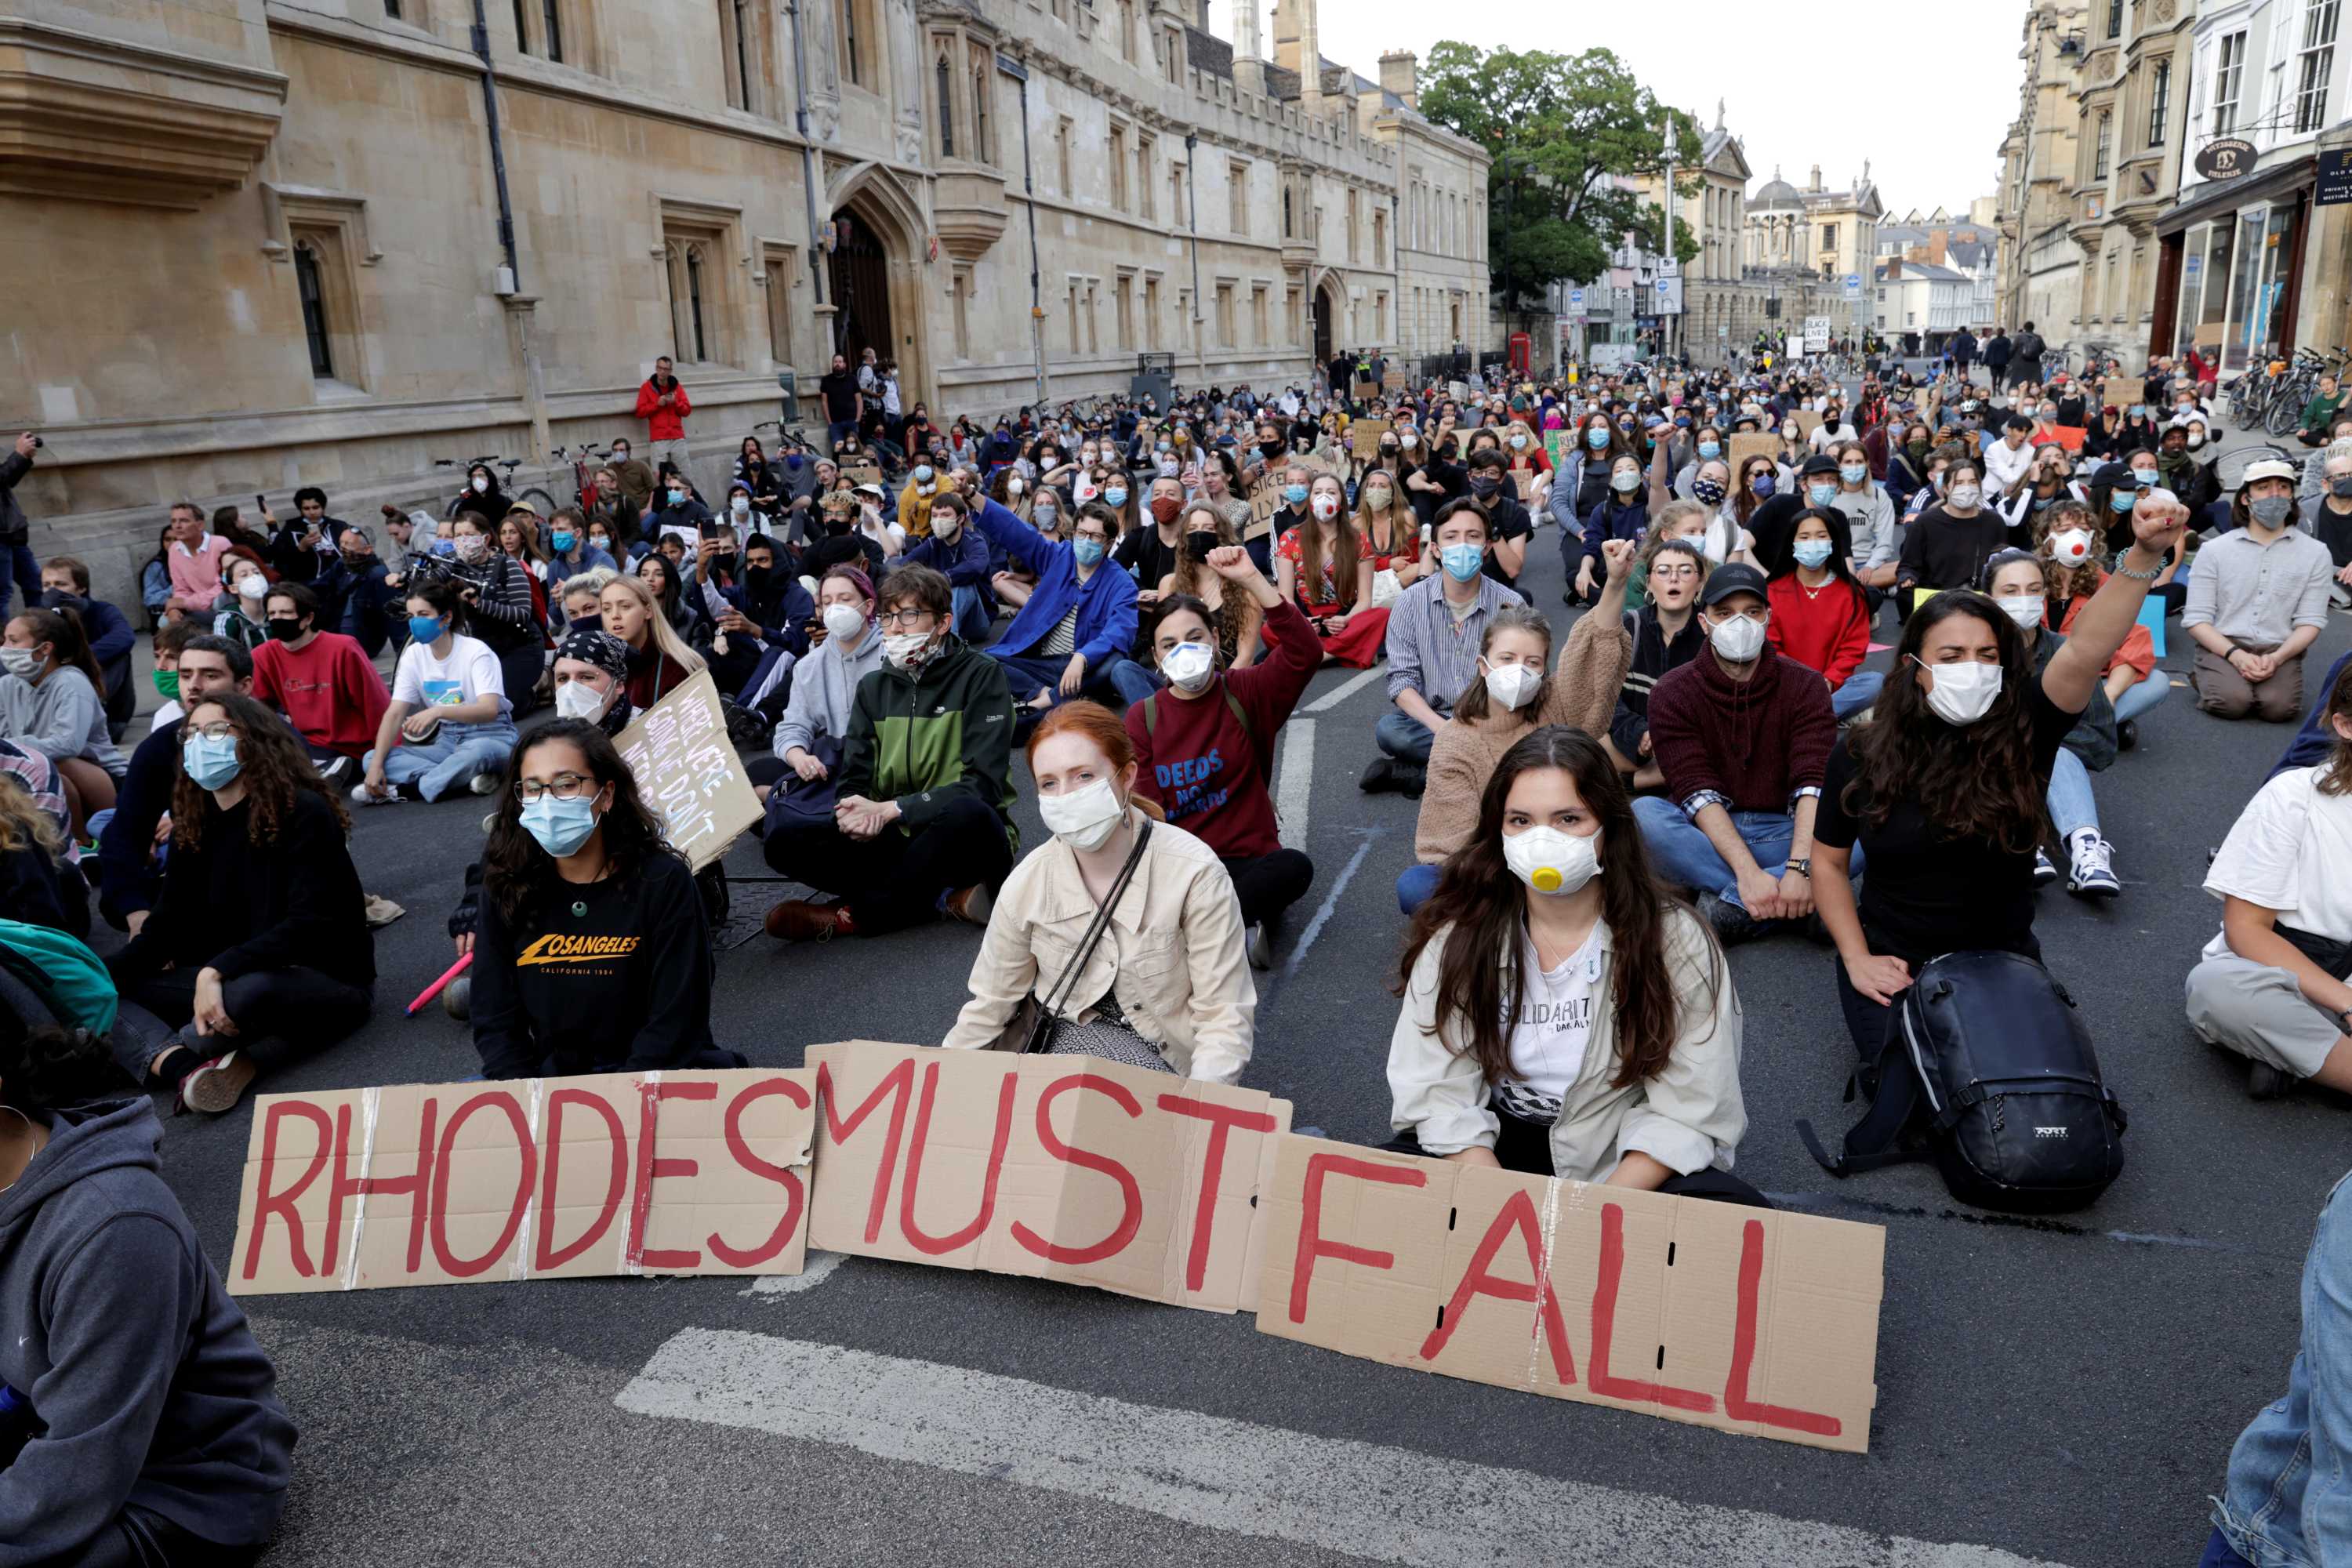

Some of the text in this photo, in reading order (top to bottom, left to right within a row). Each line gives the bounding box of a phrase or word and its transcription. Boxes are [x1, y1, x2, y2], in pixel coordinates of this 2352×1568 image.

[1155, 748, 1224, 788] DEEDS
[659, 773, 715, 849] DON'T
[243, 1058, 1842, 1437] RHODES MUST FALL
